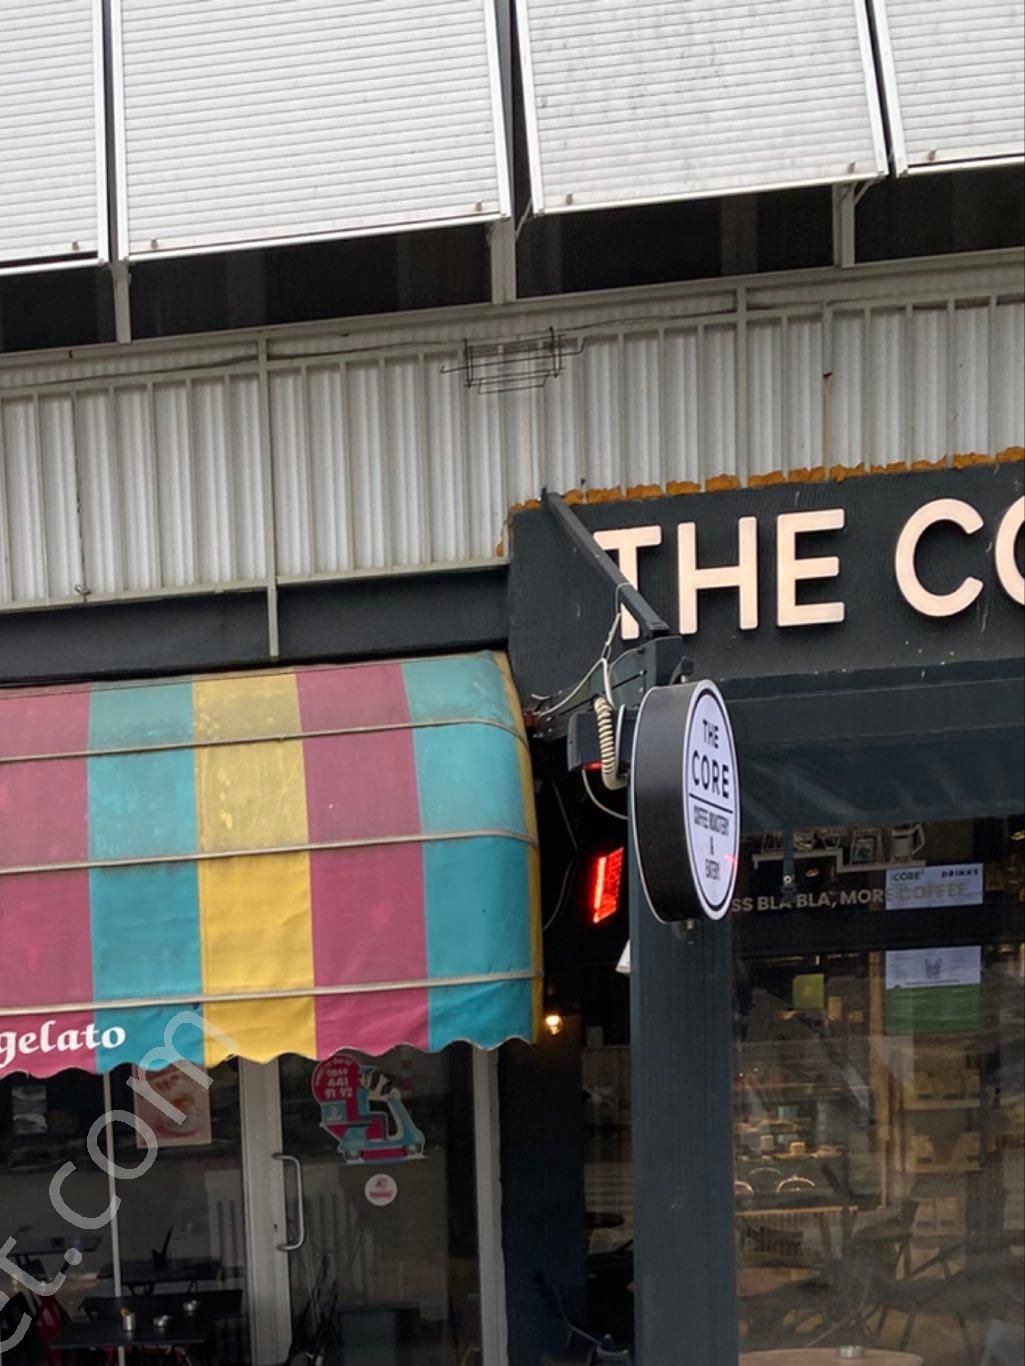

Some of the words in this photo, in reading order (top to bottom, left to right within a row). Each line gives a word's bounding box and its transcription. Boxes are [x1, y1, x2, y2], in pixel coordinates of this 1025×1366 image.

[593, 508, 845, 640] THE
[895, 498, 1025, 617] C
[703, 719, 719, 749] THE
[692, 749, 729, 799] CORE
